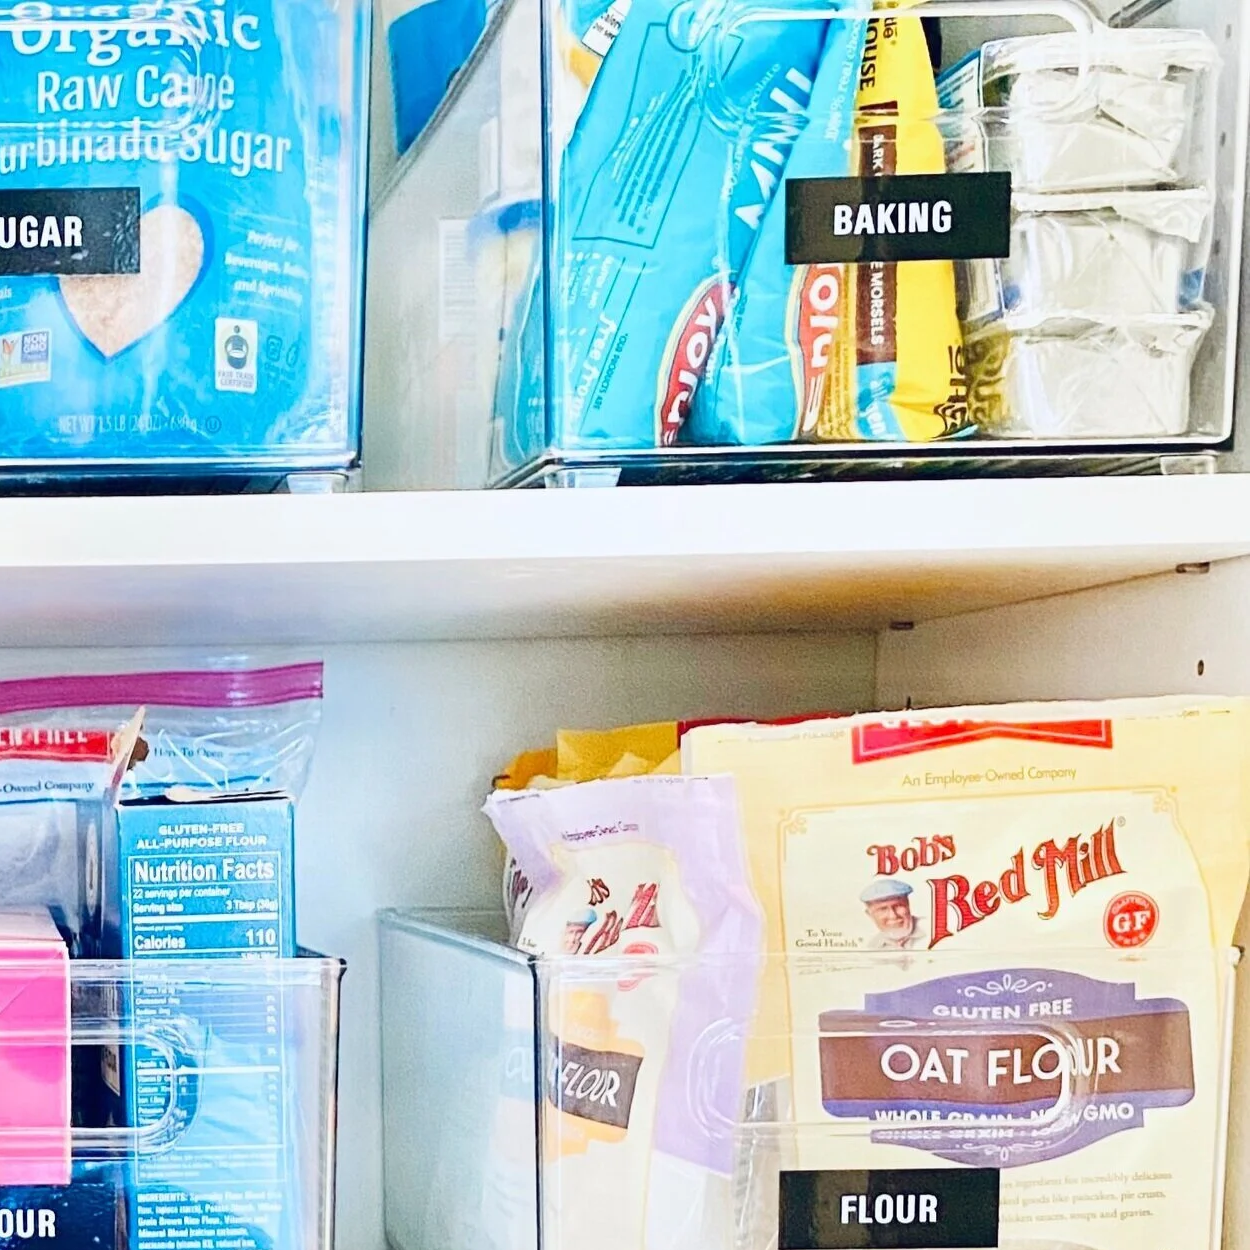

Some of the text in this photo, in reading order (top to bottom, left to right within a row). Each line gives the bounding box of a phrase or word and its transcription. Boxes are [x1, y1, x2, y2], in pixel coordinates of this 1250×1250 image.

[36, 71, 124, 114] Raw
[178, 125, 292, 178] Sugar
[834, 200, 952, 236] BAKING
[869, 276, 884, 348] MORSELS
[24, 333, 47, 344] NON
[24, 342, 48, 353] GMO
[44, 780, 95, 794] Company
[901, 766, 1077, 787] An Employee-Owned Company
[159, 823, 245, 836] GLUTEN-FREE
[137, 835, 267, 849] ALL-PURPOSE FLOUR
[867, 832, 957, 876] Bob's
[134, 858, 275, 882] Nutrition Facts
[133, 887, 231, 900] 22 servings per container
[927, 817, 1127, 950] Red Mill
[133, 902, 184, 914] Serving size
[1112, 912, 1148, 934] GF
[134, 936, 186, 950] Calories
[246, 928, 276, 945] 110
[795, 939, 822, 948] Good
[933, 998, 1073, 1020] GLUTEN FREE
[881, 1037, 1121, 1087] OAT FLOUR
[840, 1193, 938, 1225] FLOUR
